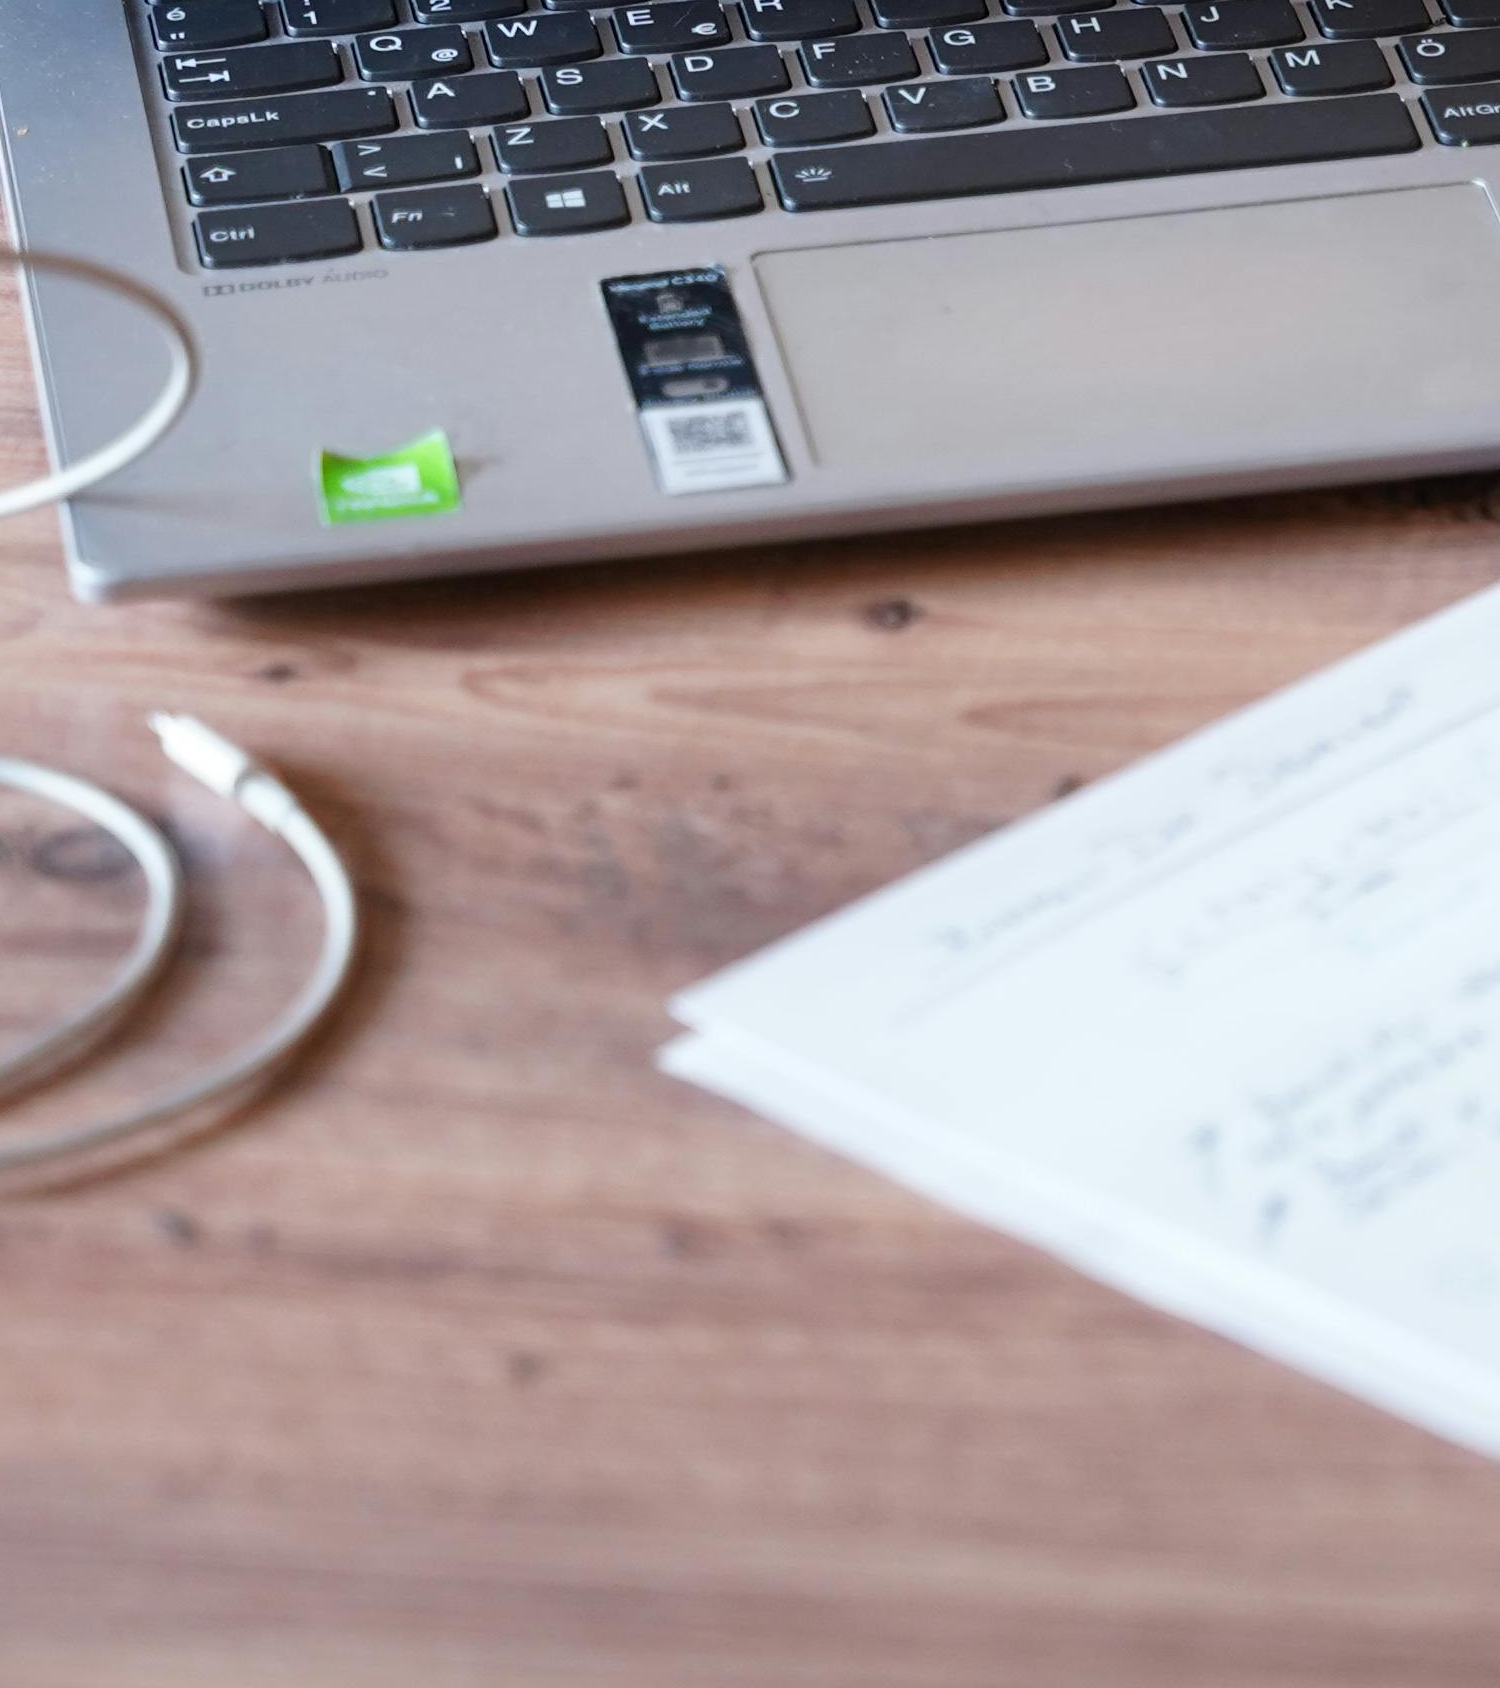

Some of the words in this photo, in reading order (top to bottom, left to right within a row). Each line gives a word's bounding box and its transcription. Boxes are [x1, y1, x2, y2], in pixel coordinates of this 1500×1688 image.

[302, 11, 318, 26] 1
[368, 35, 404, 54] Q
[497, 20, 539, 40] W
[625, 8, 657, 27] E
[185, 110, 281, 130] CapsLk
[425, 81, 456, 101] A
[554, 68, 584, 87] S
[683, 55, 716, 74] D
[811, 42, 838, 60] F
[942, 28, 978, 47] G
[1069, 16, 1103, 35] H
[1199, 5, 1222, 24] J
[504, 128, 536, 147] Z
[638, 113, 670, 133] X
[767, 101, 801, 120] C
[896, 86, 930, 106] V
[1026, 75, 1058, 94] B
[1156, 62, 1190, 81] N
[1284, 48, 1321, 68] M
[1415, 38, 1447, 59] Ö
[209, 225, 256, 243] Ctrl
[390, 209, 425, 224] Fn
[656, 180, 692, 197] Alt
[238, 276, 315, 293] DOLBY
